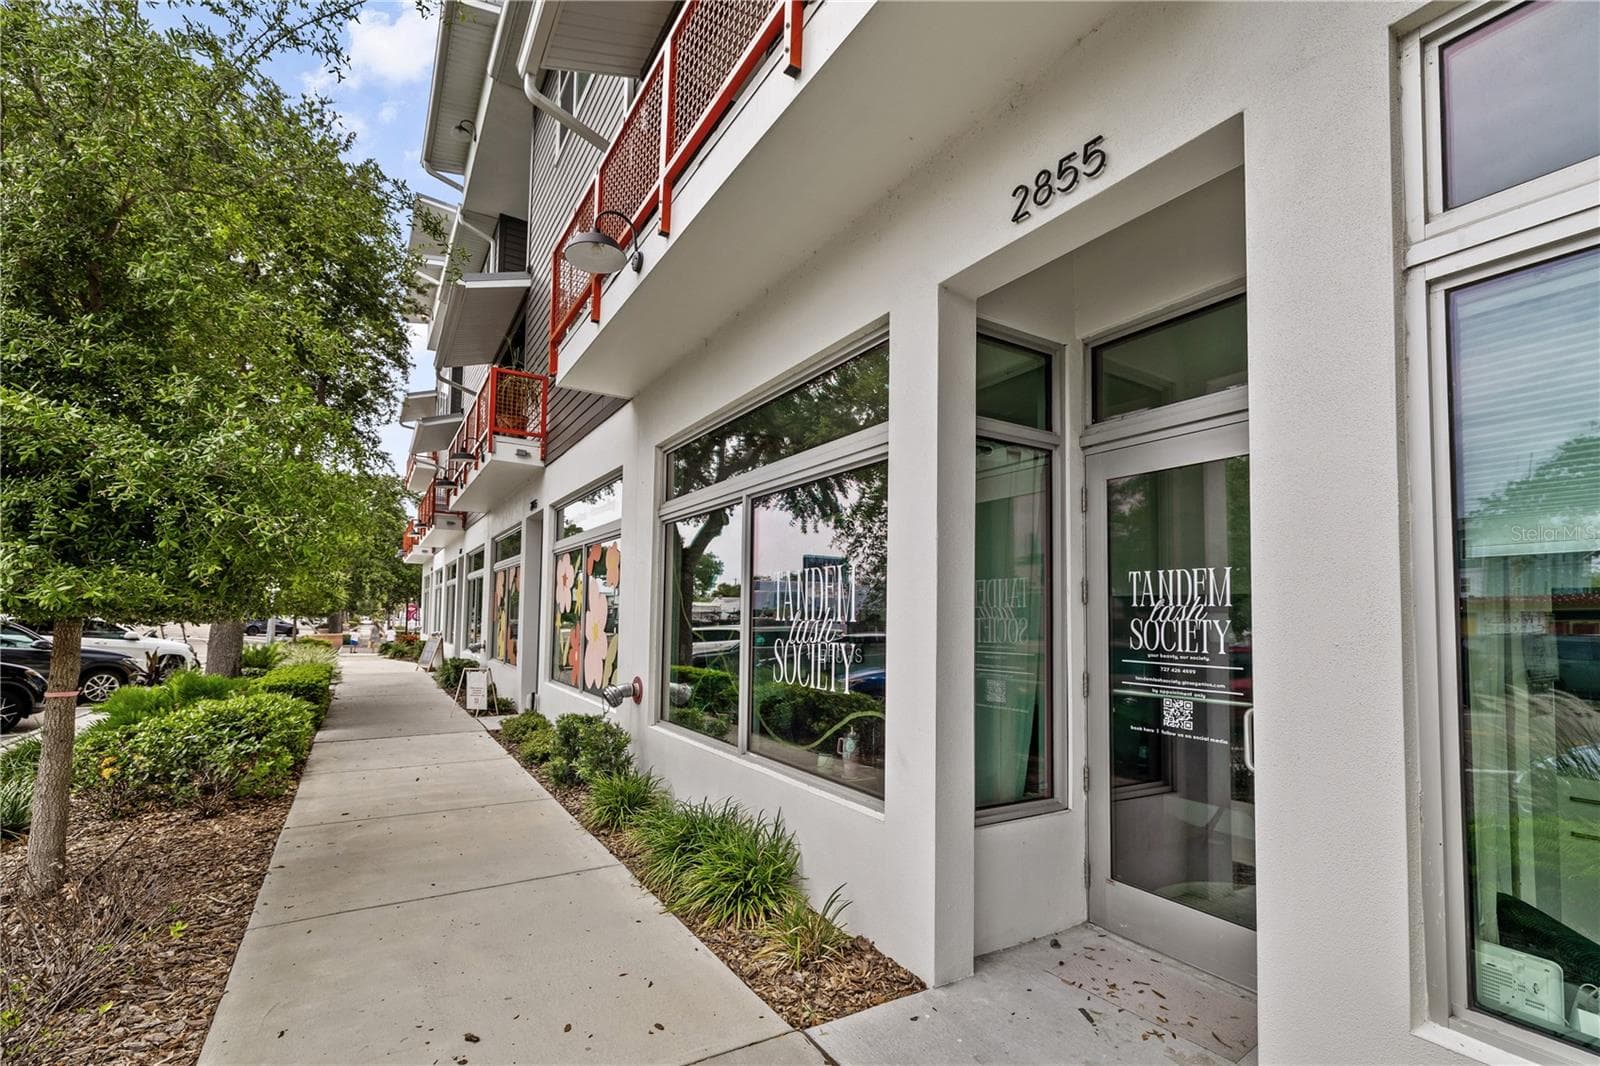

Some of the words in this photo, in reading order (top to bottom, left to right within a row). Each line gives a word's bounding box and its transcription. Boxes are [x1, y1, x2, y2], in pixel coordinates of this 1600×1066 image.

[1010, 134, 1106, 223] 2855
[773, 562, 858, 623] TANDEM
[1128, 566, 1233, 608] TANDEM
[788, 607, 837, 645] lash
[1149, 596, 1209, 624] lash
[1129, 617, 1232, 655] SOCIETY
[773, 637, 858, 695] SOCIETY
